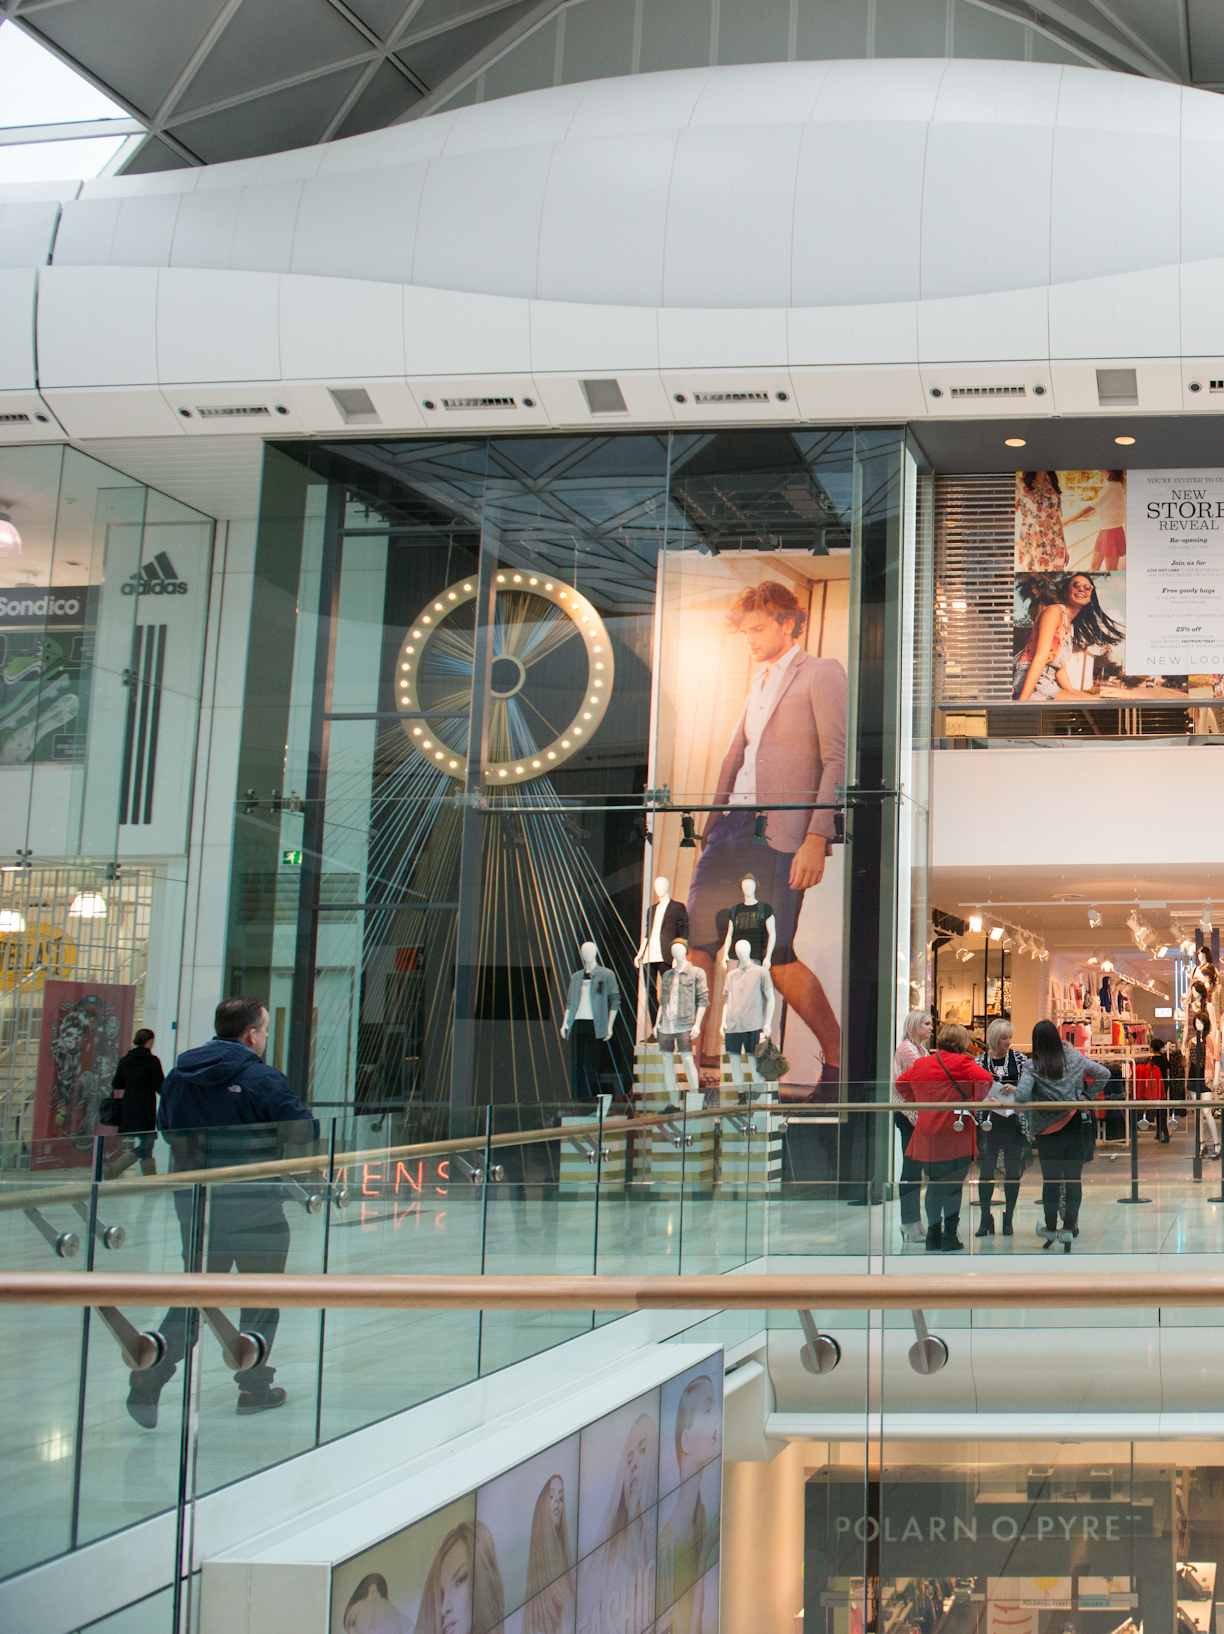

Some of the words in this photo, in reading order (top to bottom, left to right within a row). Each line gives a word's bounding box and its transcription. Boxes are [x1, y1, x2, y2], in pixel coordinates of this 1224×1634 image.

[1171, 489, 1207, 500] NEW
[1159, 520, 1219, 531] REVEAL
[120, 579, 188, 596] adidas
[0, 596, 80, 617] Sondico
[1147, 656, 1181, 665] NEW
[834, 1515, 978, 1542] POLARN
